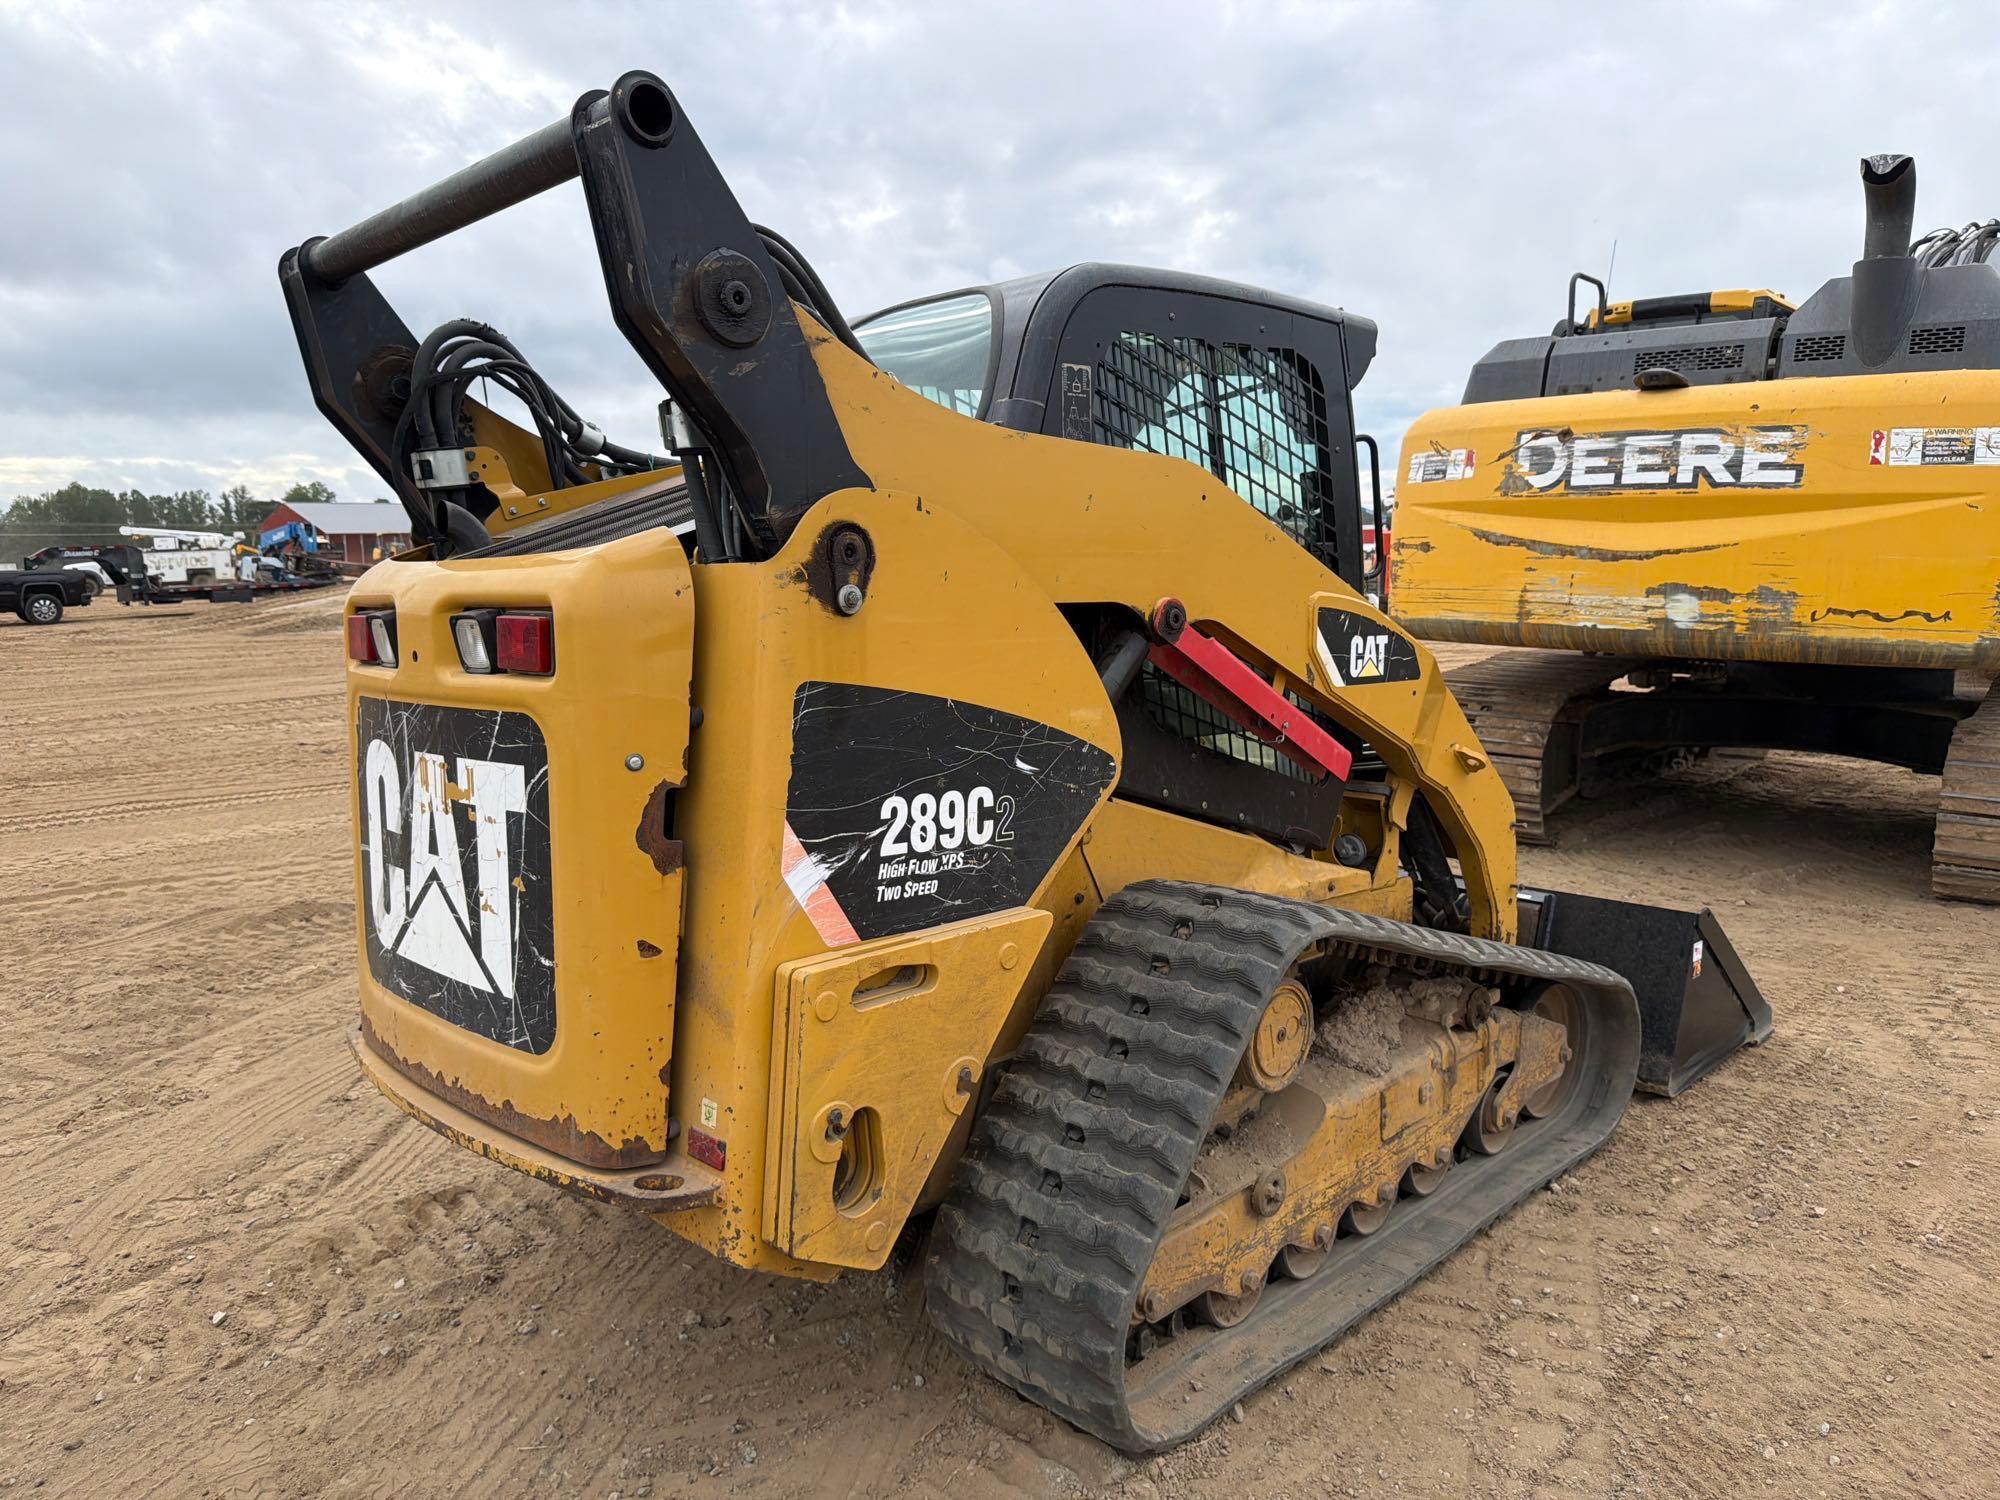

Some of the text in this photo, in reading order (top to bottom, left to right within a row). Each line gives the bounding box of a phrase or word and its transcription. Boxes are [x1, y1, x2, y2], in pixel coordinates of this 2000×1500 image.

[1934, 428, 1974, 436] WARNING
[1516, 430, 1806, 489] DEERE
[150, 554, 209, 571] Service
[1349, 634, 1389, 678] CAT
[366, 738, 527, 1000] CAT
